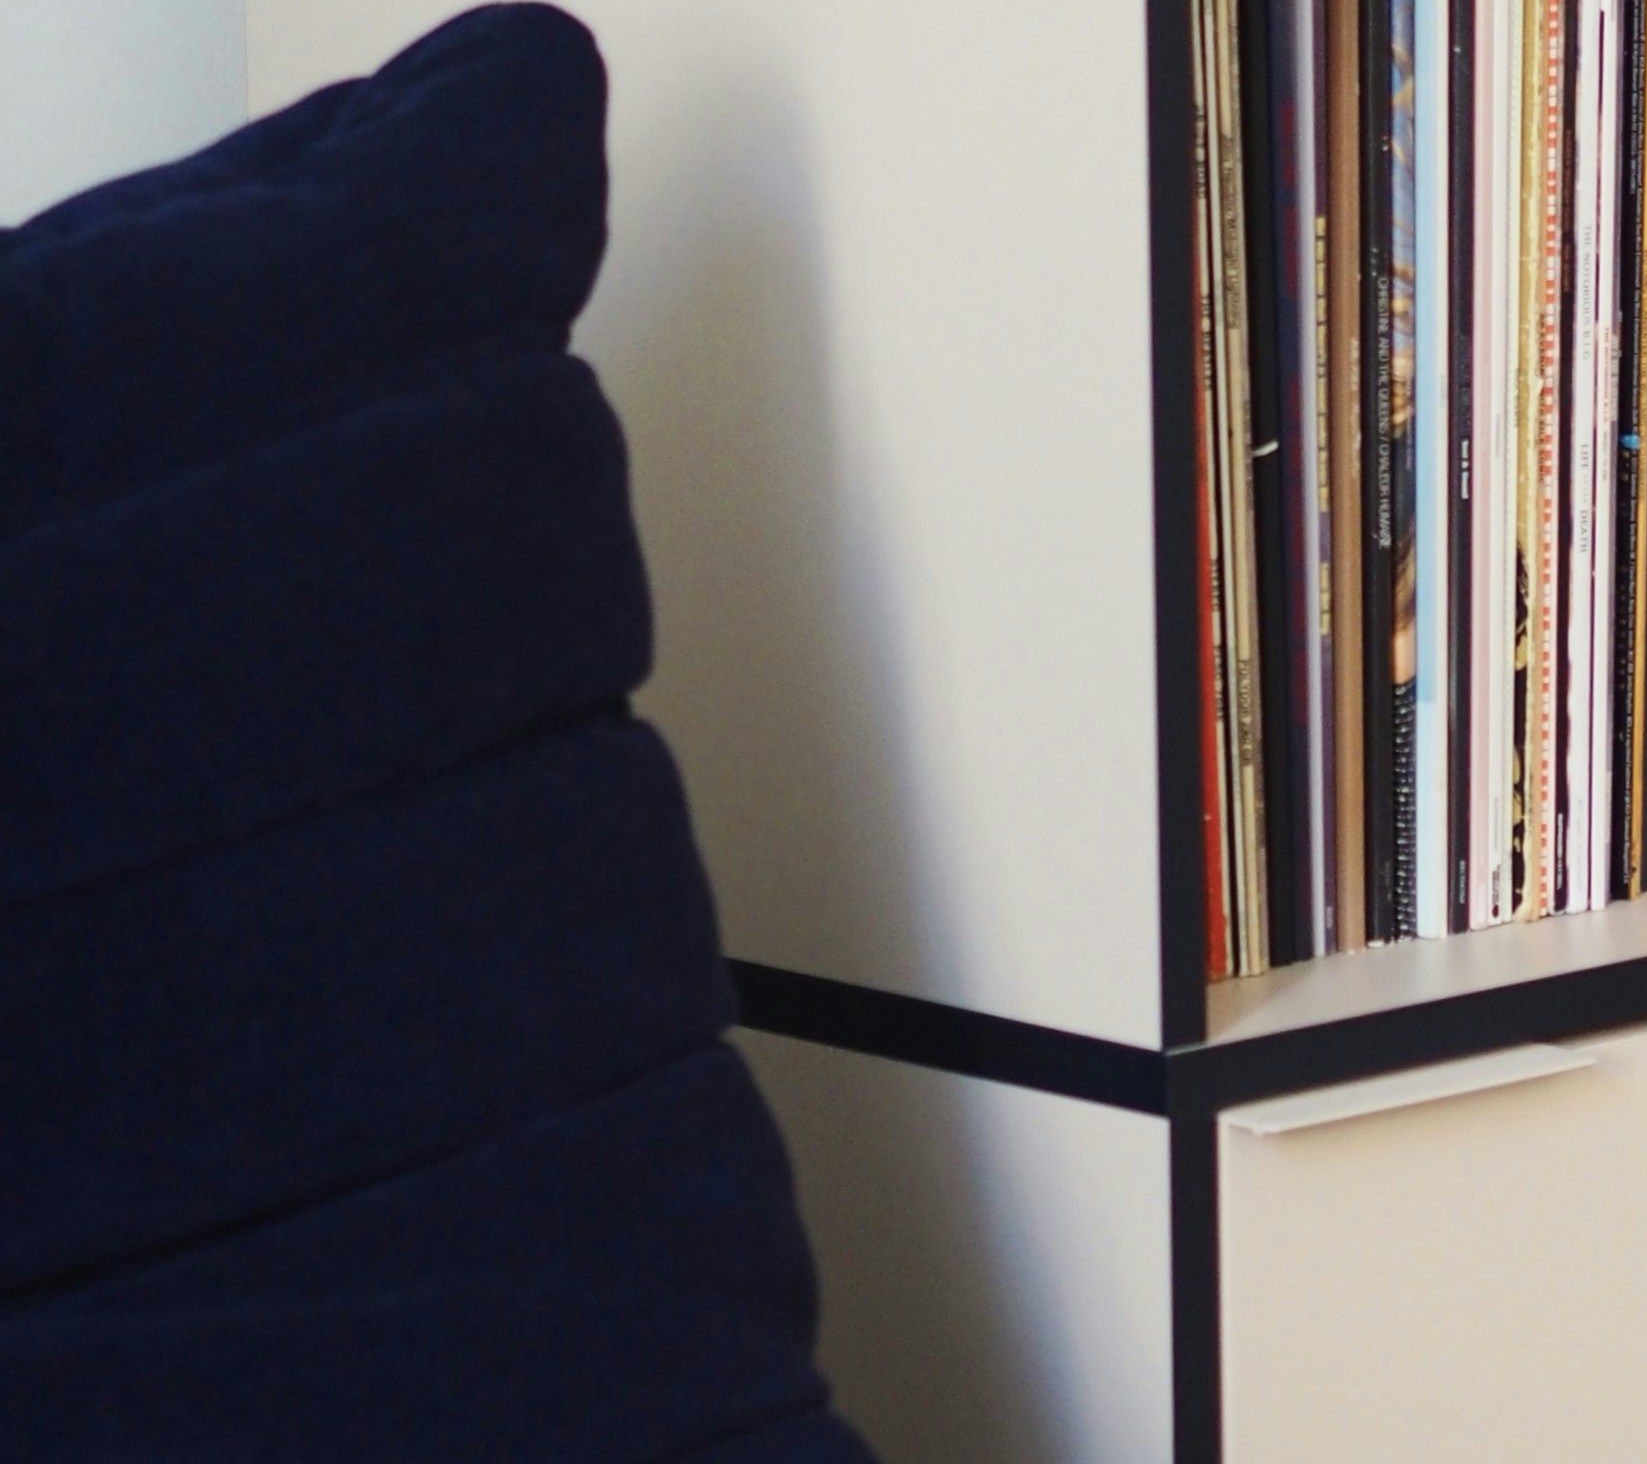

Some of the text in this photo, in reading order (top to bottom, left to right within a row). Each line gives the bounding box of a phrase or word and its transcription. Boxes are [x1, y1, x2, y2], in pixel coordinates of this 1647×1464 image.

[1583, 224, 1592, 247] THE
[1582, 252, 1592, 326] NOTORIOUS
[1378, 338, 1390, 363] AND
[1378, 366, 1390, 386] THE
[1378, 389, 1390, 435] QUEENS
[1579, 509, 1589, 554] DEATH
